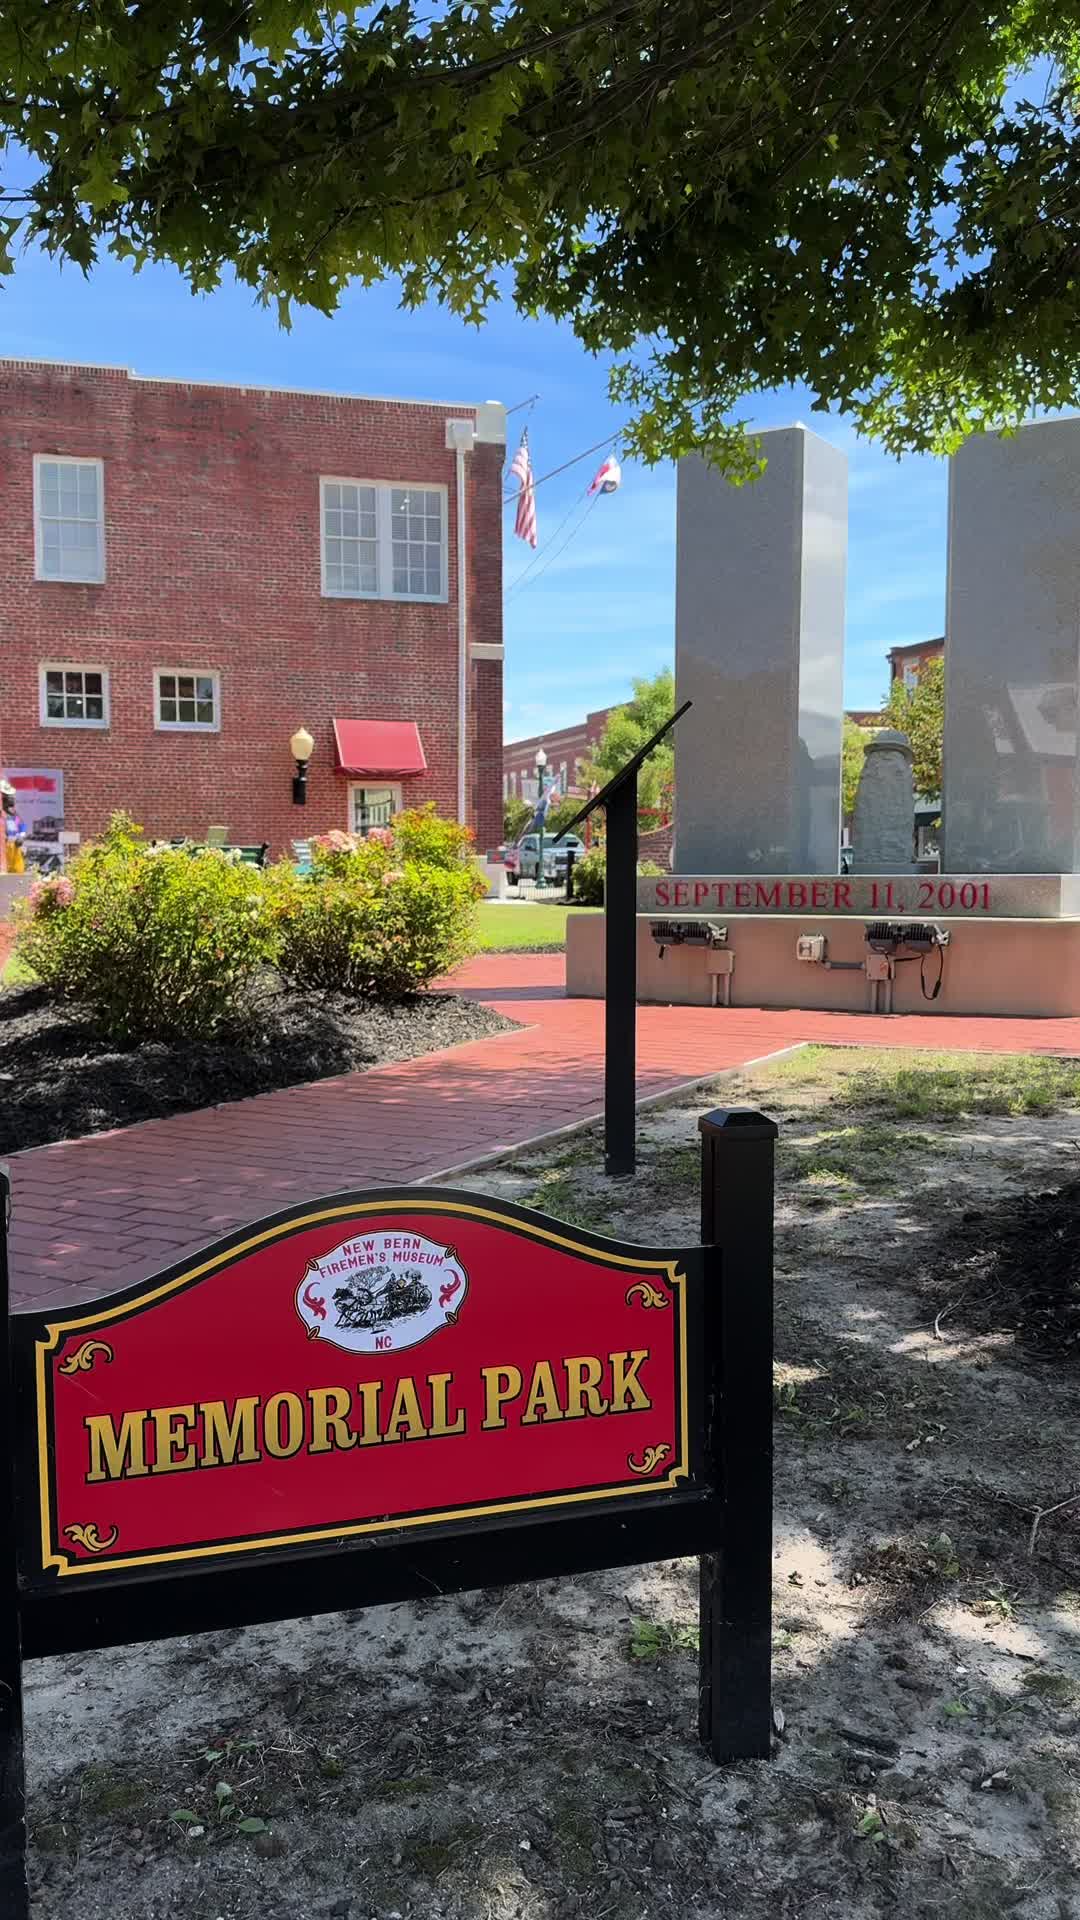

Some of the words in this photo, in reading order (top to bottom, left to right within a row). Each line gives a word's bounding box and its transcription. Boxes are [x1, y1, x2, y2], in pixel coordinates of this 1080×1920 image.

[655, 881, 853, 909] SEPTEMBER
[869, 882, 905, 912] 11,
[918, 882, 993, 910] 2001
[342, 1240, 375, 1256] NEW
[384, 1238, 421, 1250] BERN
[320, 1252, 386, 1279] FIREMEN'S
[392, 1251, 445, 1266] MUSEUM
[375, 1336, 392, 1350] NC
[84, 1372, 467, 1484] MEMORIAL
[480, 1348, 653, 1430] PARK
